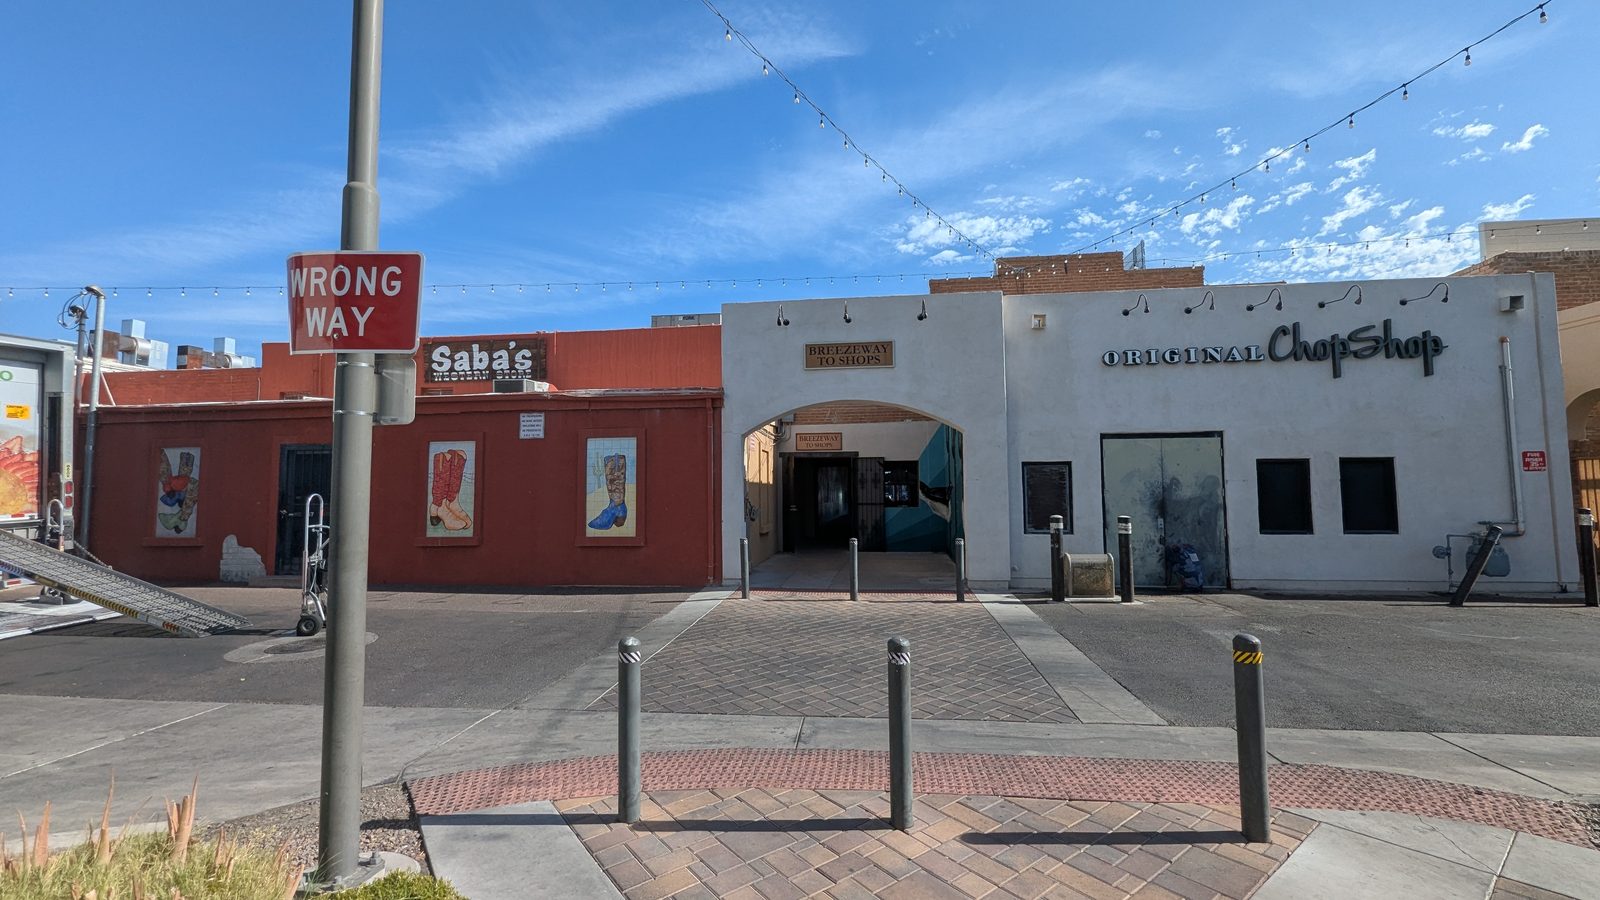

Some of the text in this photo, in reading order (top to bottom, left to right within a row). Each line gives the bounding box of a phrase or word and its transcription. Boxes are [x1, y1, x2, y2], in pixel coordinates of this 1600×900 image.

[290, 265, 402, 298] WRONG
[305, 306, 375, 338] WAY
[431, 341, 533, 372] Saba's
[809, 344, 889, 356] BREEZEWAY
[817, 355, 881, 366] TO SHOPS
[1102, 318, 1449, 379] ORIGINAL ChopShop
[433, 370, 532, 381] WESTERN STORE
